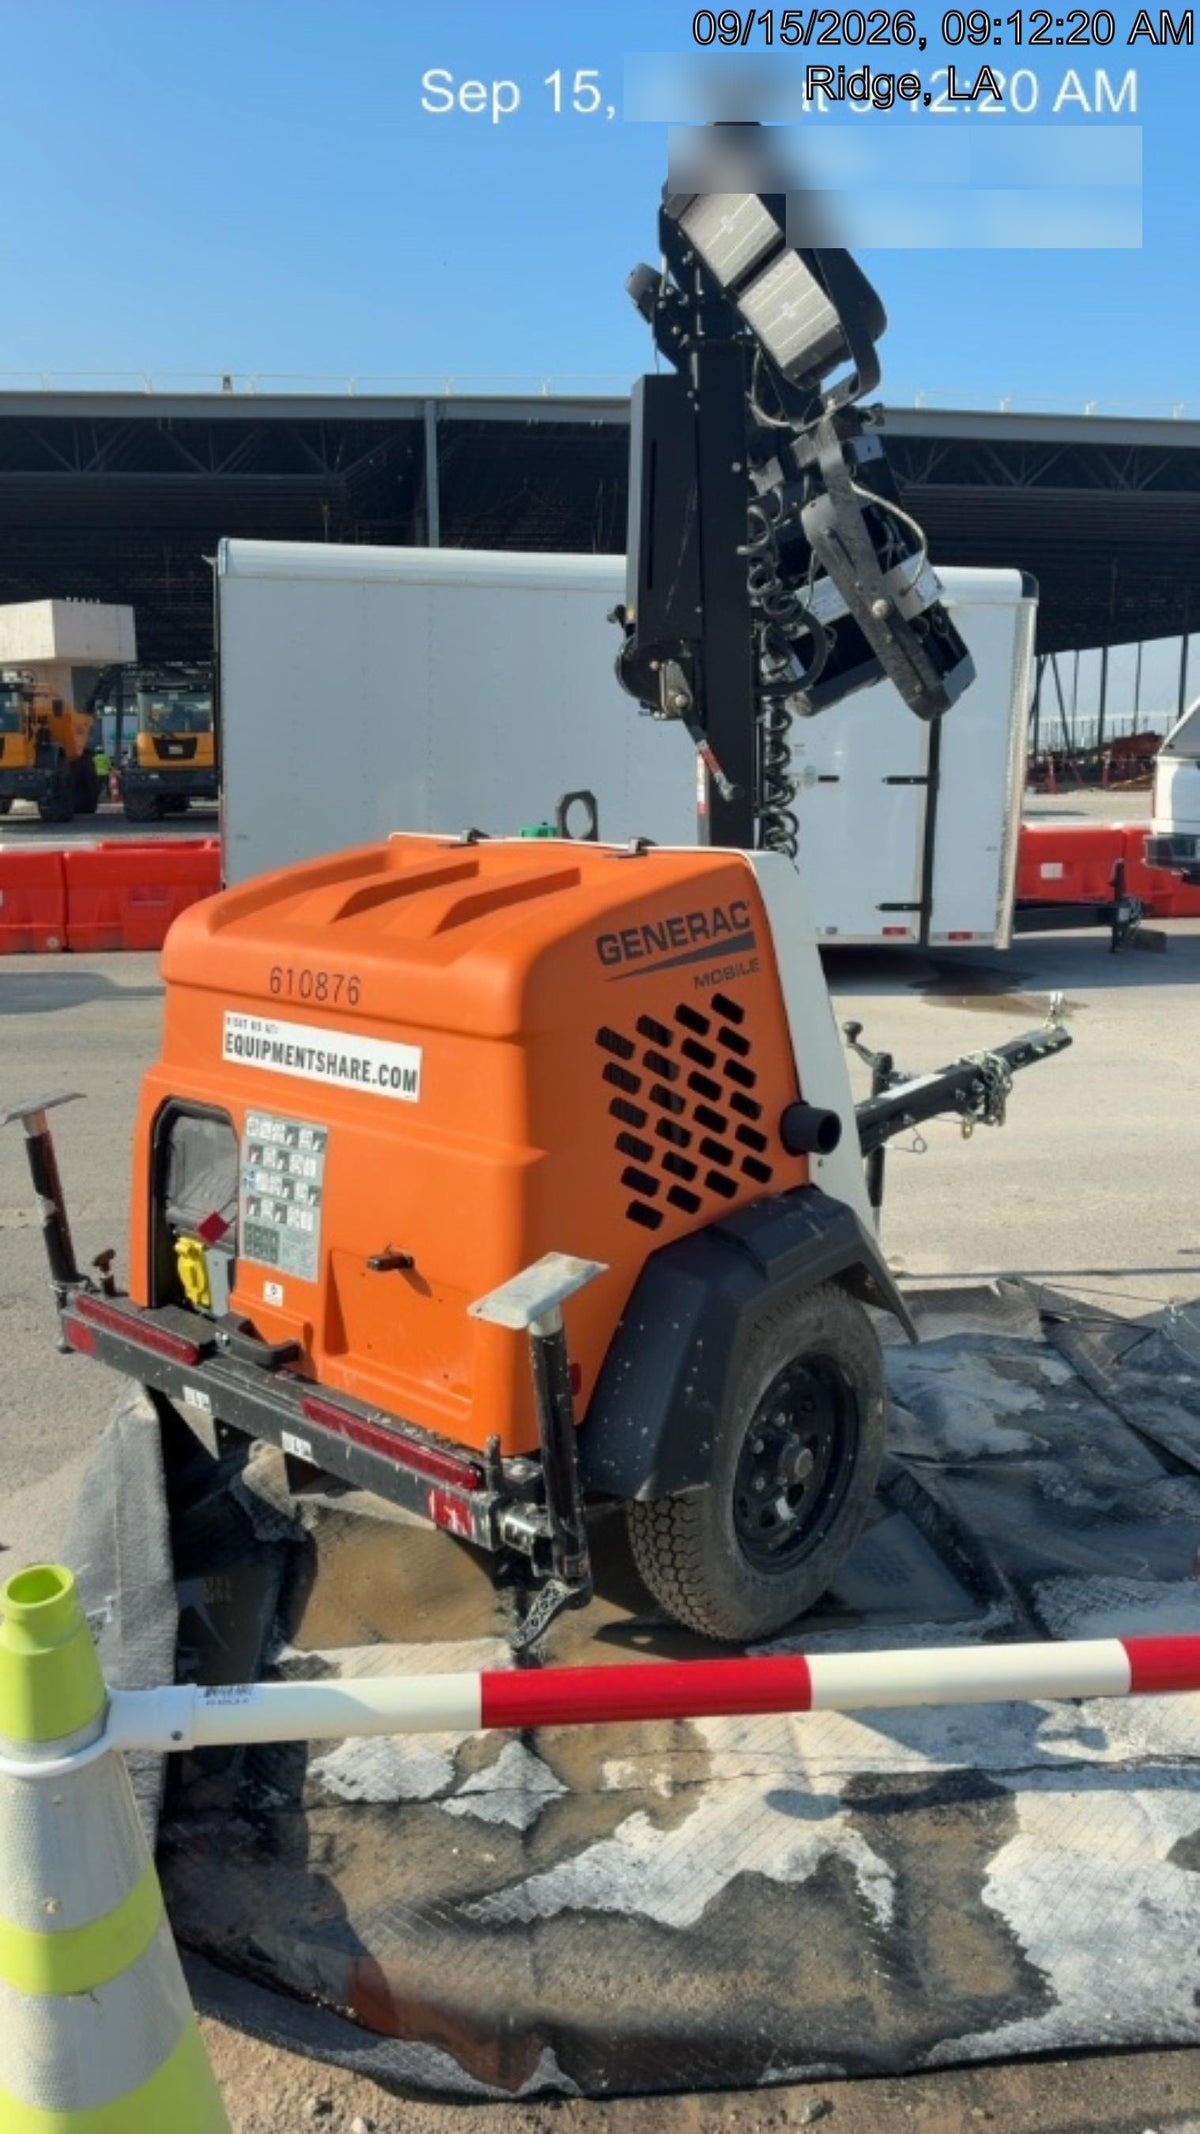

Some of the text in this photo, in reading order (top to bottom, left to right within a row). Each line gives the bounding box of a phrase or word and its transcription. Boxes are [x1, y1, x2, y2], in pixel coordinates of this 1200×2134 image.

[595, 901, 750, 965] GENERAC
[269, 966, 361, 1005] 610876
[693, 957, 760, 989] MOBILE
[225, 1032, 418, 1093] EQUIPMENTSHARE.COM
